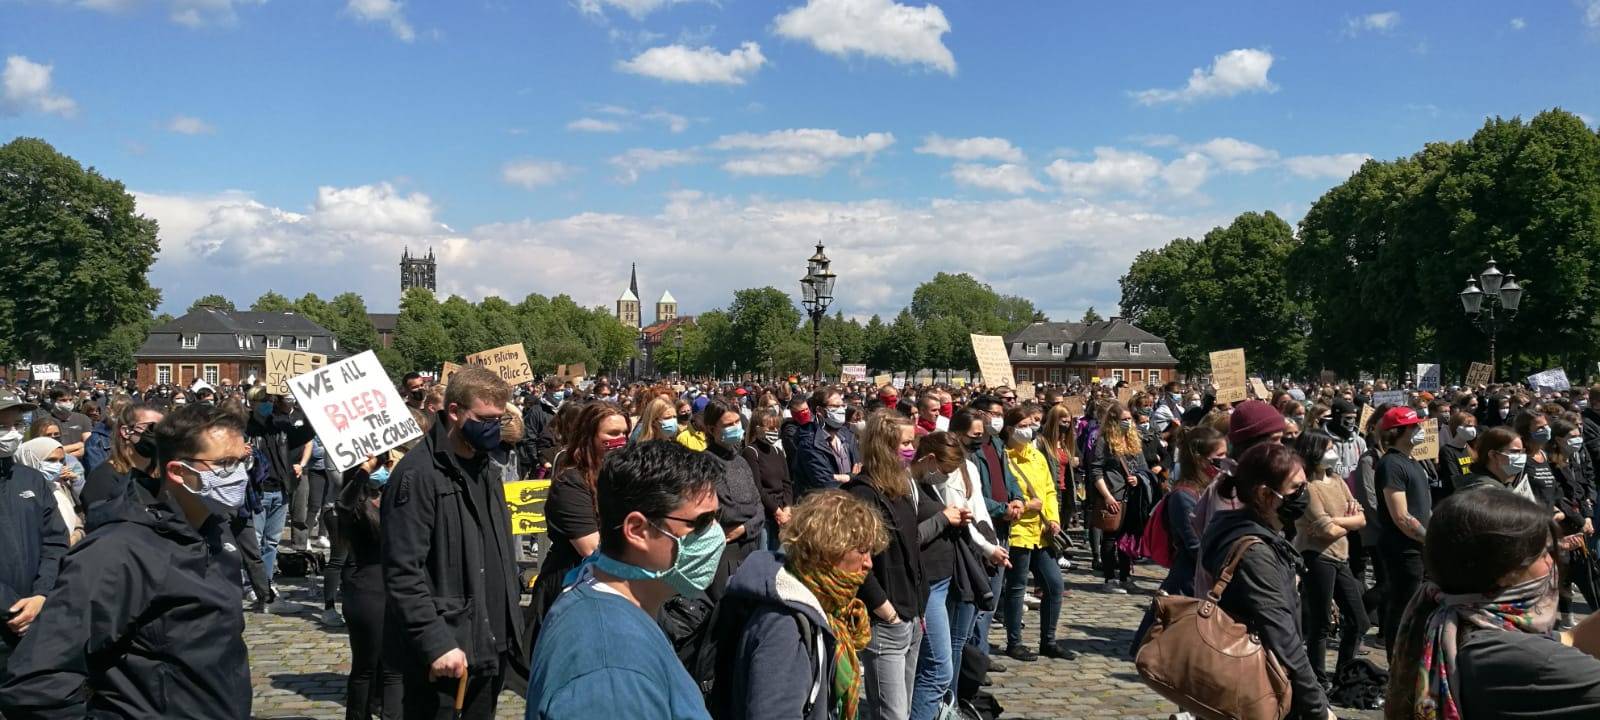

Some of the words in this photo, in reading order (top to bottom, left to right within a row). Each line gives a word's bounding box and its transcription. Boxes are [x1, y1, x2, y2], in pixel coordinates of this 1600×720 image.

[270, 351, 306, 375] WE
[271, 384, 292, 394] TO
[297, 369, 335, 400] WE
[340, 360, 367, 384] ALL
[324, 389, 387, 432] BLEED
[363, 410, 391, 429] THE
[335, 432, 382, 468] SAME
[382, 418, 421, 446] COLOUR
